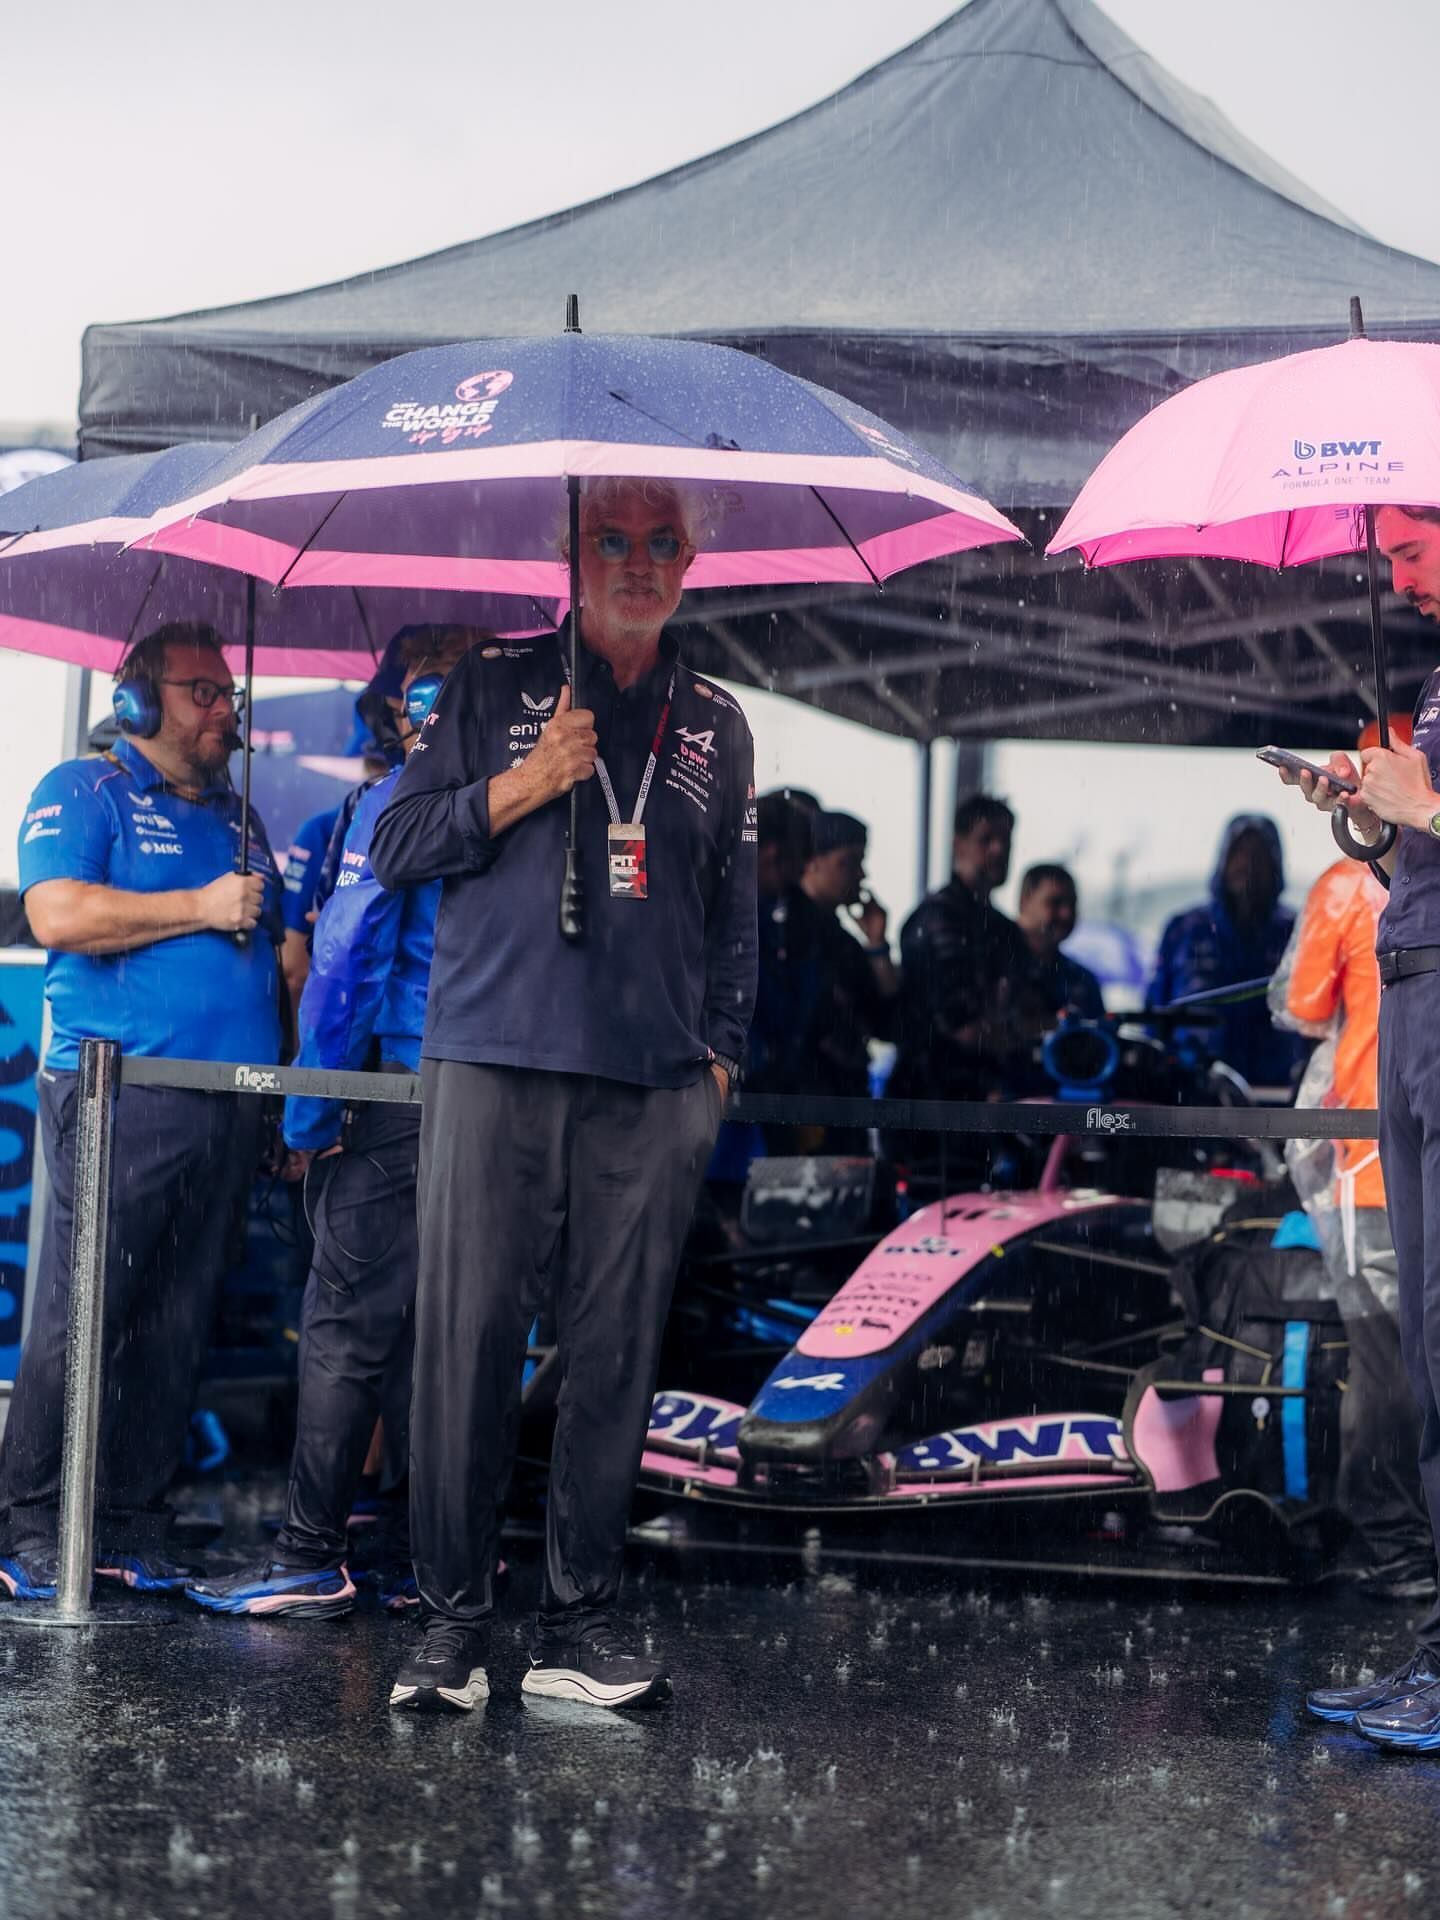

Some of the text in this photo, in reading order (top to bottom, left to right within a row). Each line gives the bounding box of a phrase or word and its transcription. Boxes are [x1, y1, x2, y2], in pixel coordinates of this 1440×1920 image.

[386, 400, 499, 421] CHANGE
[402, 414, 490, 432] WORLD
[1321, 441, 1382, 457] BWT
[1271, 461, 1404, 478] ALPINE
[1282, 478, 1329, 490] FORMULA
[1365, 477, 1391, 485] TEAM
[509, 722, 538, 736] eni
[672, 753, 713, 780] ALPINE
[153, 842, 184, 855] MSC
[649, 1396, 742, 1449] BW
[900, 1419, 1122, 1471] BWT
